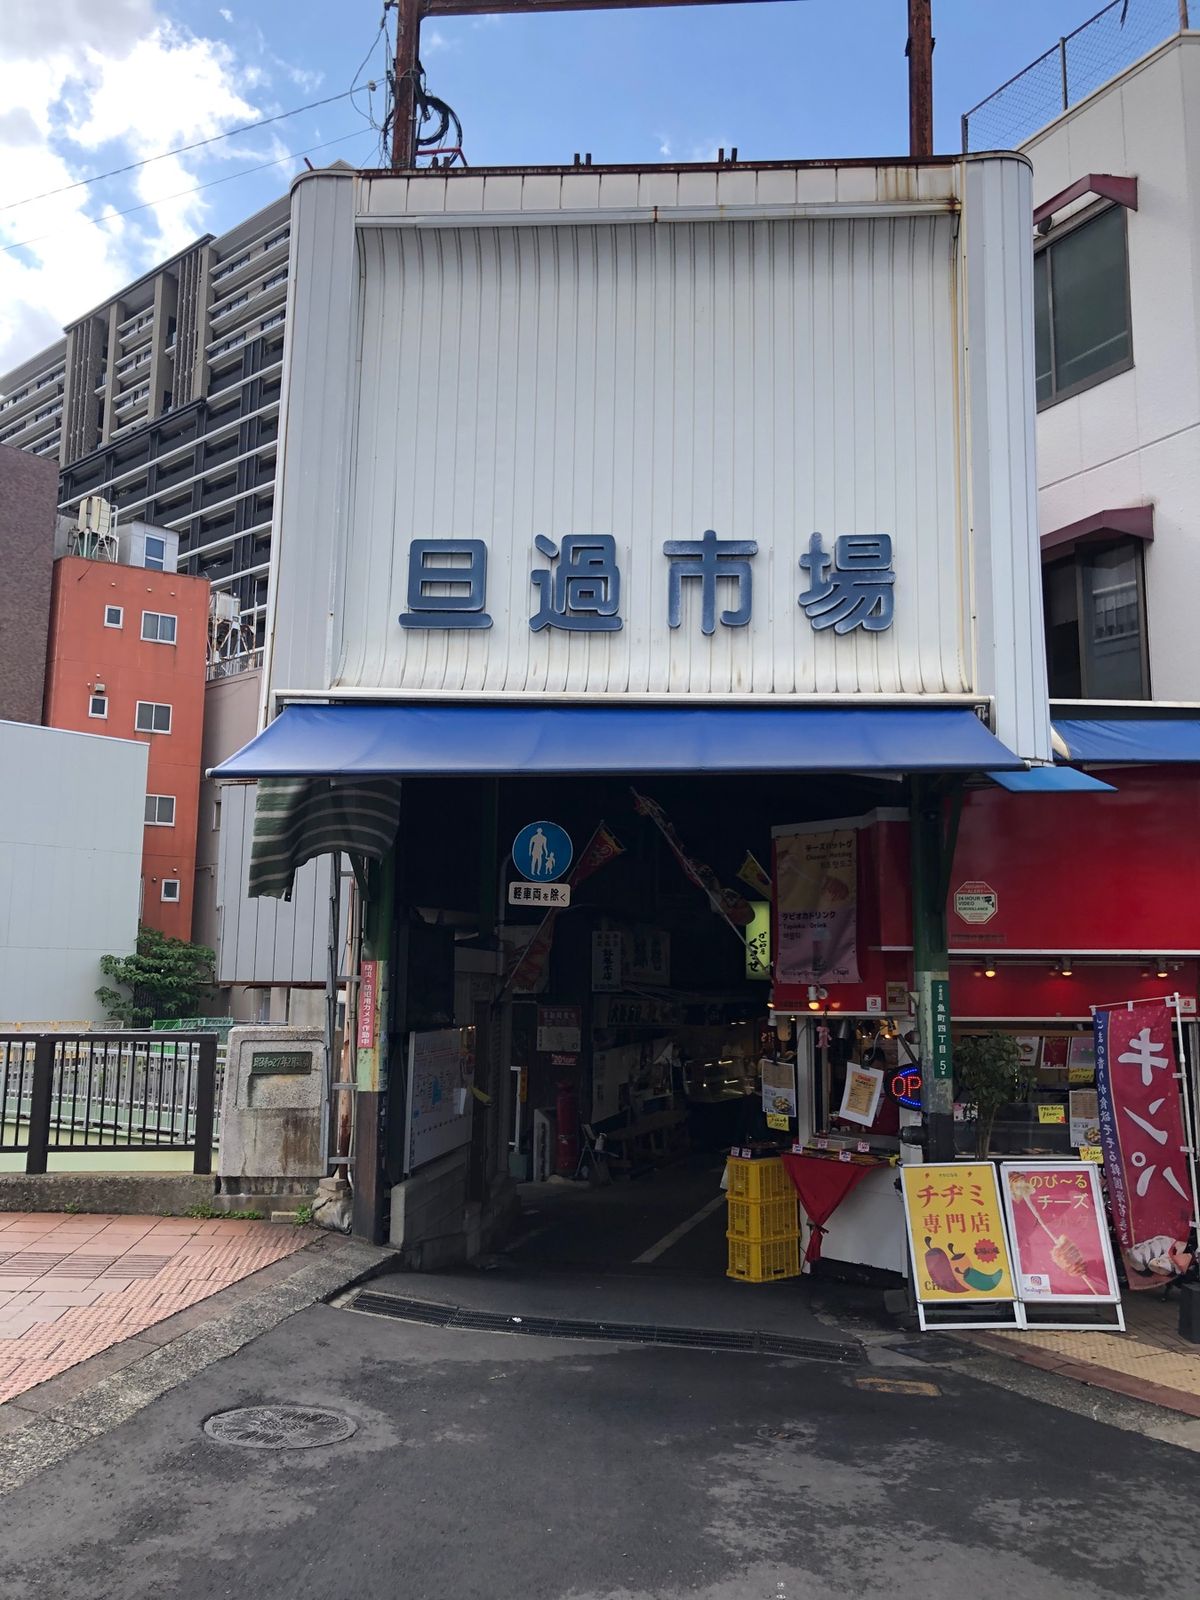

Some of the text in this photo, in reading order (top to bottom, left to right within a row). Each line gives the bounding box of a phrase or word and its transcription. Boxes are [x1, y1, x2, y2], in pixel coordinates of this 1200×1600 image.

[398, 529, 897, 637] 旦過市場
[513, 886, 567, 902] 軽車両を除く
[937, 1003, 947, 1054] 魚町四丁目
[1117, 1028, 1190, 1202] キンパ
[916, 1184, 985, 1208] チヂミ
[1036, 1193, 1089, 1210] チーズ
[922, 1212, 990, 1234] 専門店
